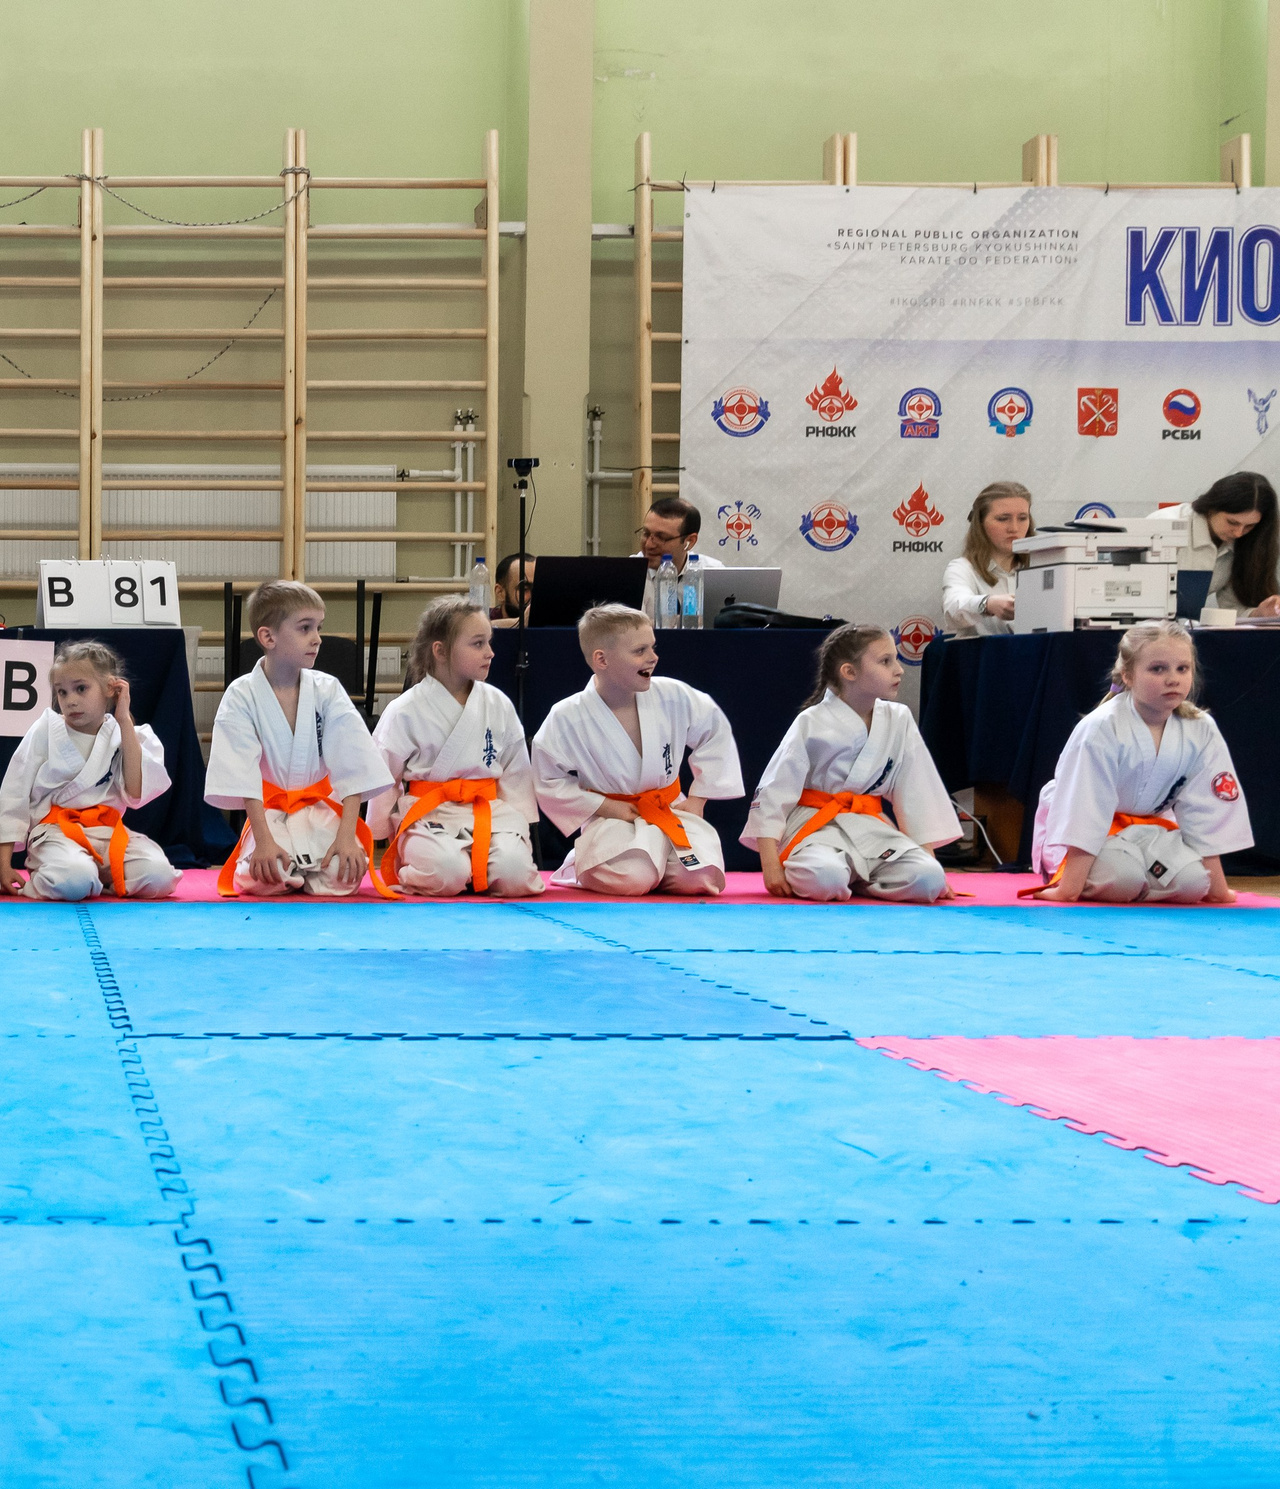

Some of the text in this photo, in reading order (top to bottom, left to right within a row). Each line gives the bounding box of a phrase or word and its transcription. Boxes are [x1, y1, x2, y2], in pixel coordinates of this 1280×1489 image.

[837, 228, 1079, 239] REGIONAL PUBLIC ORGANIZATION
[881, 242, 968, 252] PETERSBURG
[975, 242, 1078, 252] KYOKUSHINKAI
[805, 425, 856, 438] РНФКК
[1162, 429, 1201, 440] РСБИ
[892, 540, 943, 553] РНФКК
[47, 576, 74, 607] B
[2, 660, 39, 711] B
